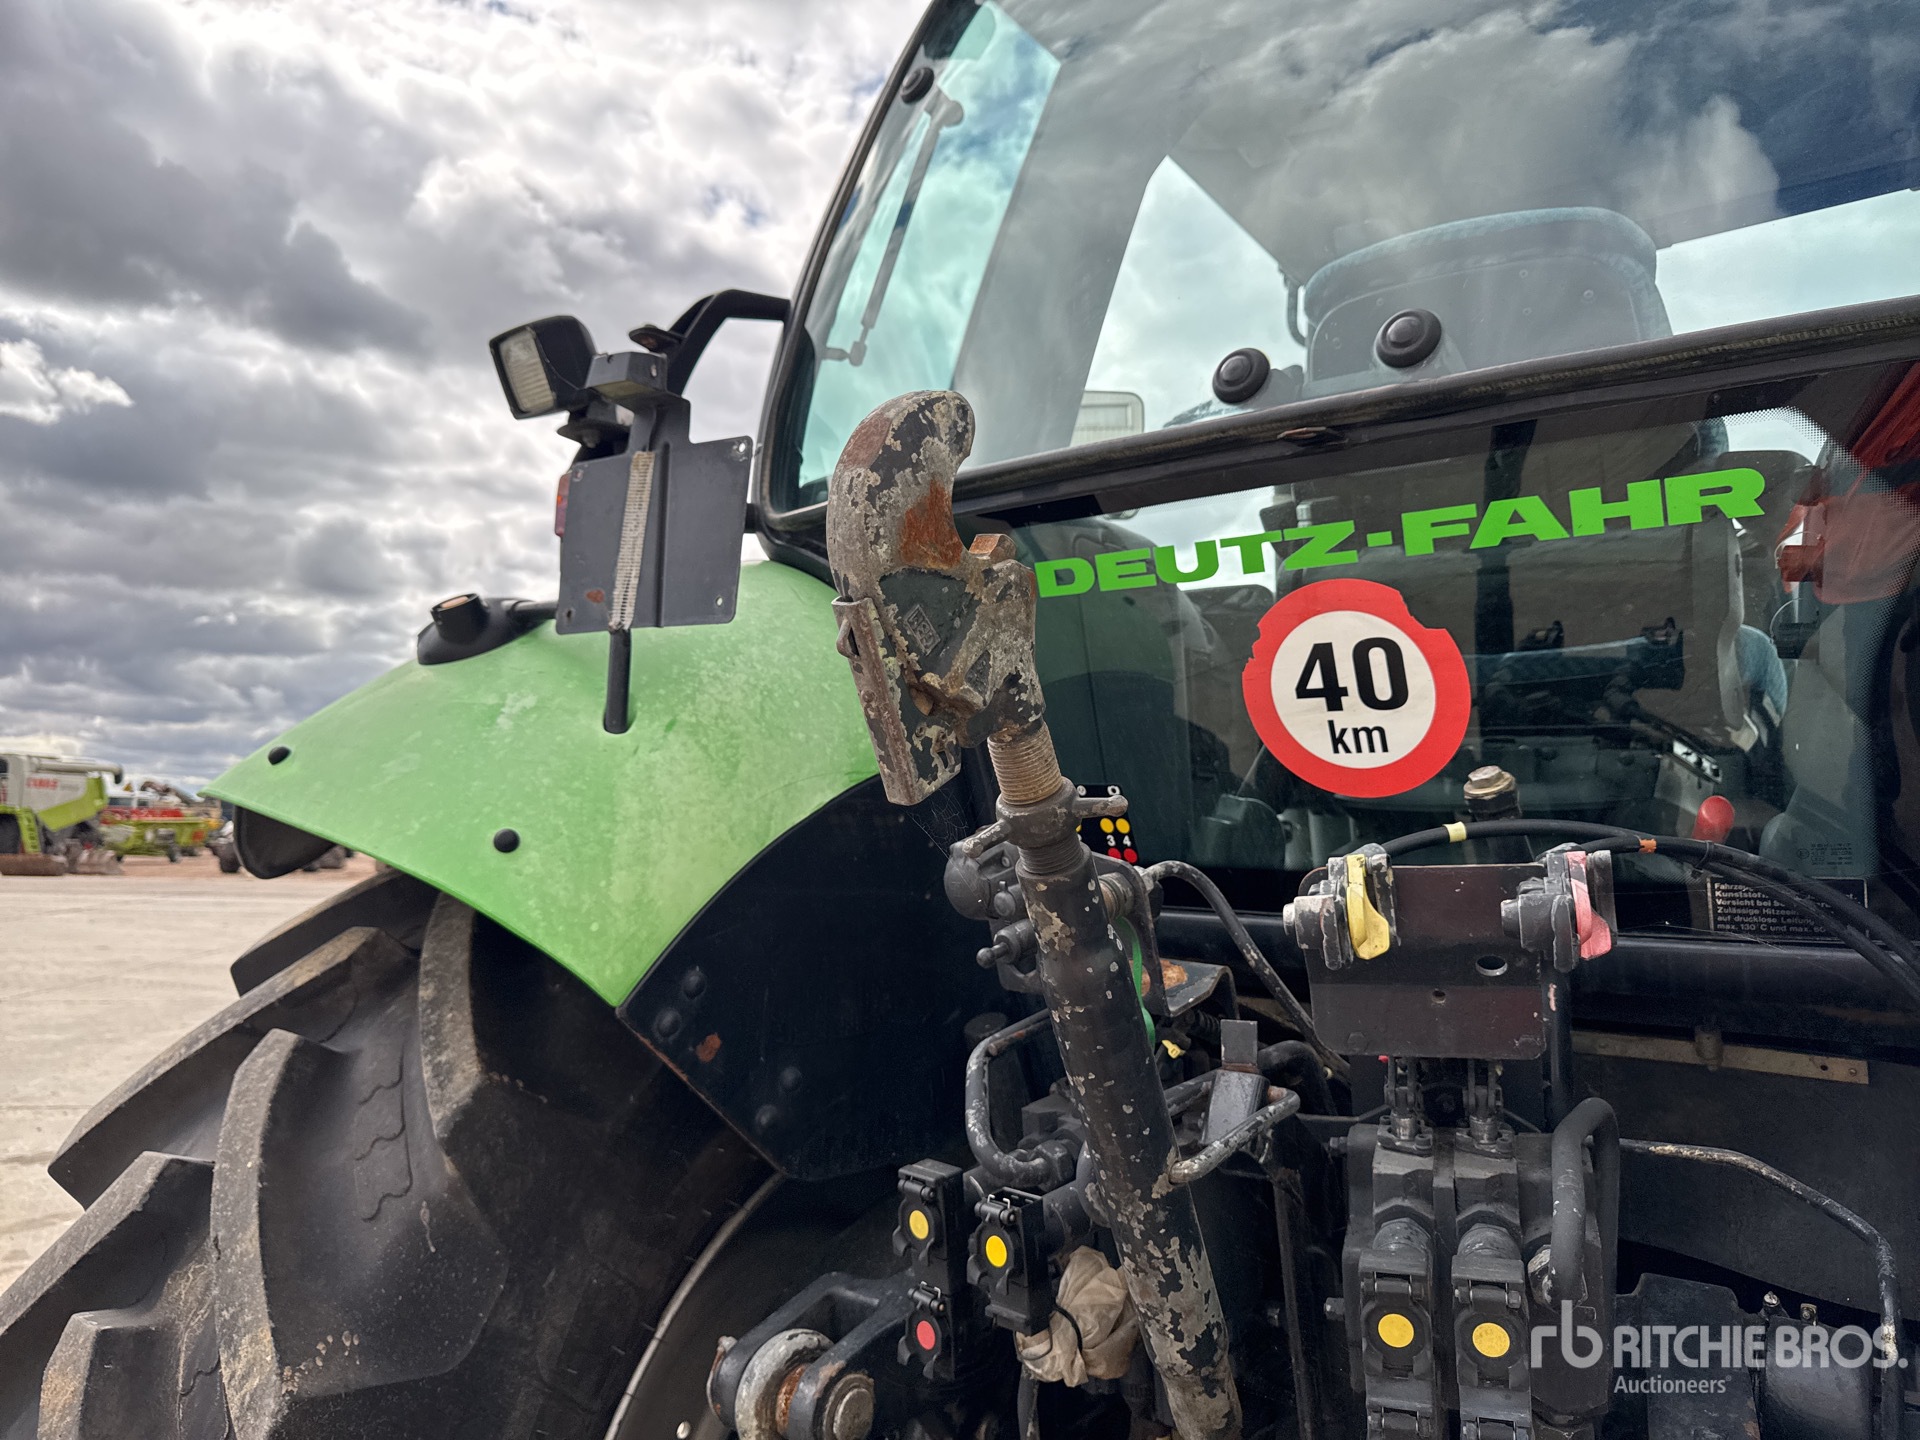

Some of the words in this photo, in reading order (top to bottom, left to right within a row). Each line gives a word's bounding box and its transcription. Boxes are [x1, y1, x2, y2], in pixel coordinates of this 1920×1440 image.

[1034, 468, 1765, 597] DEUTZ-FAHR
[1295, 637, 1409, 712] 40
[1328, 720, 1389, 754] km
[1106, 834, 1116, 847] 3
[1122, 834, 1132, 847] 4
[1715, 898, 1755, 907] Vorsicht
